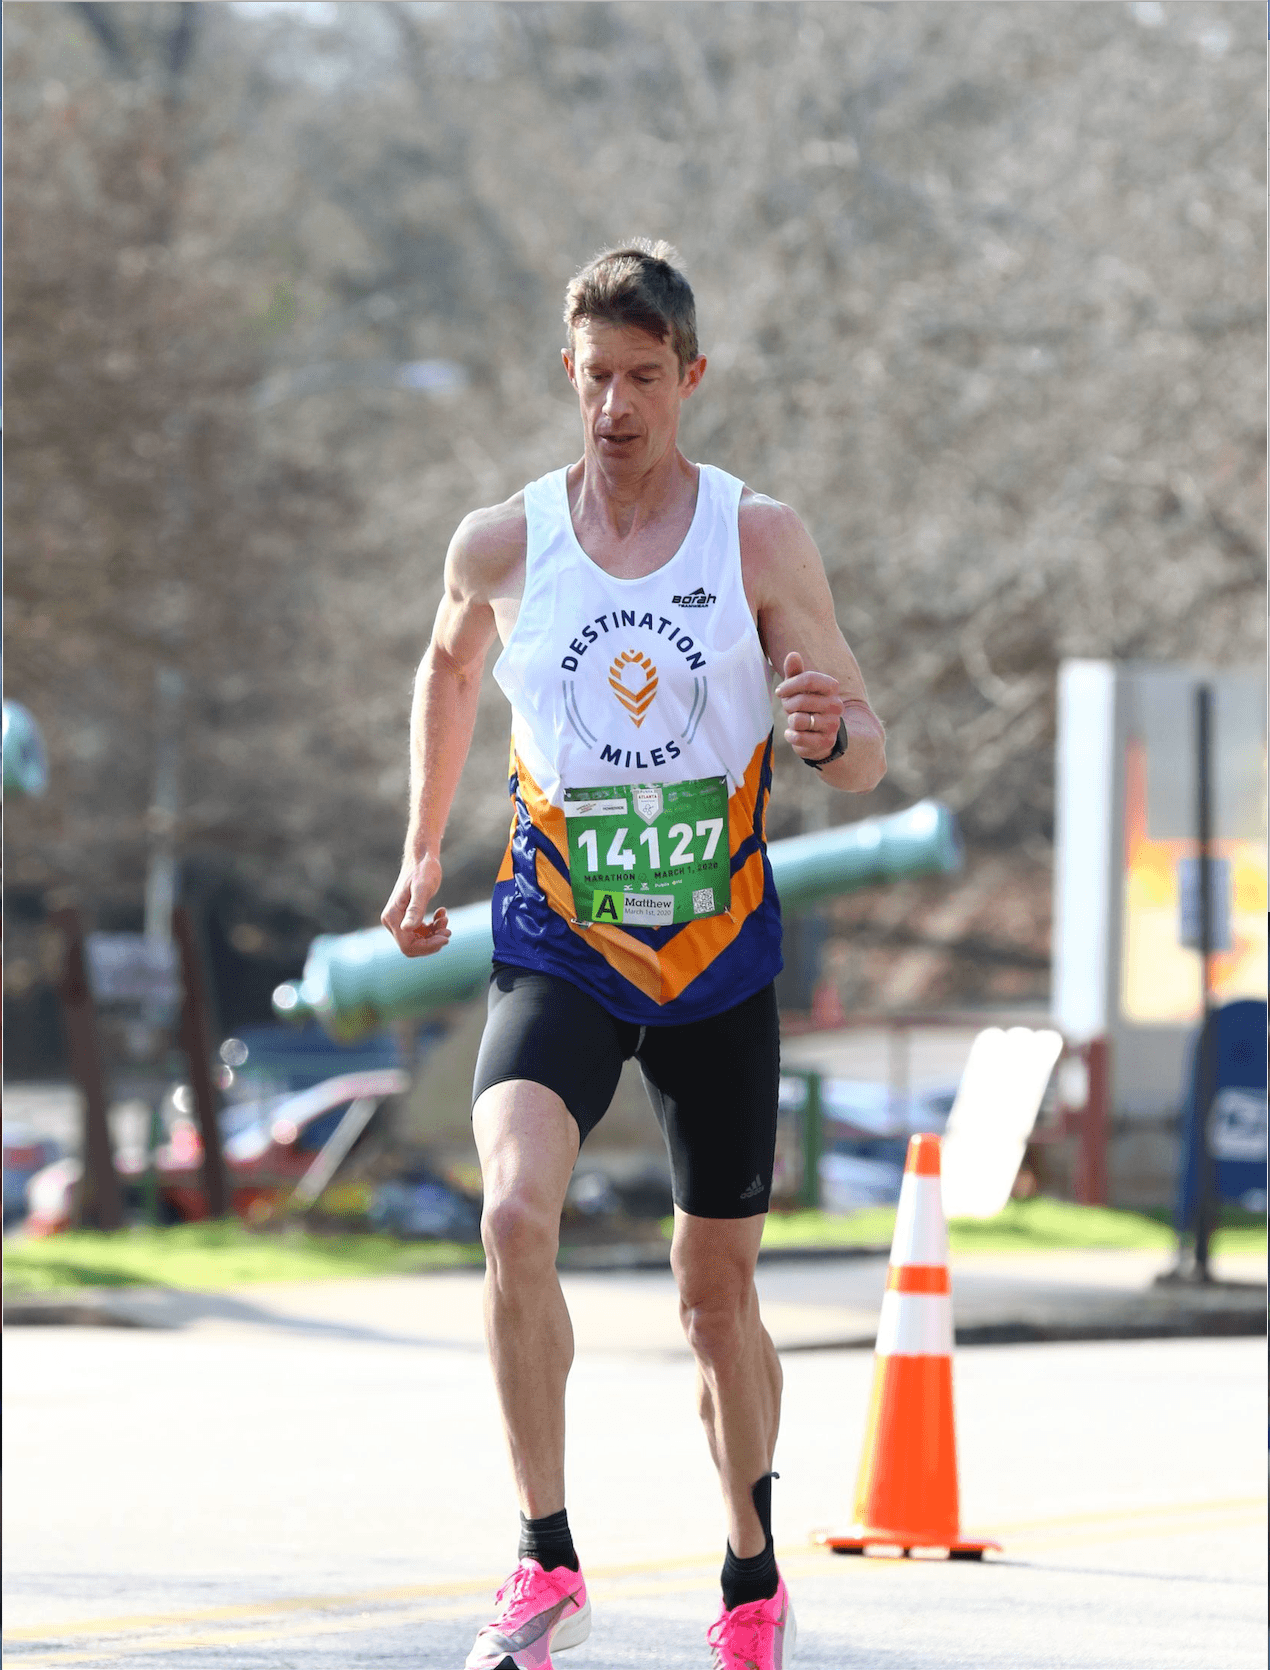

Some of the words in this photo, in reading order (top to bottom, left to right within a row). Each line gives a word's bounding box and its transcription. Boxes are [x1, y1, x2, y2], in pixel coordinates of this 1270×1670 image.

[561, 610, 706, 672] DESTINATION
[600, 740, 681, 768] MILES
[577, 818, 724, 872] 14127
[584, 873, 636, 882] MARATHON
[654, 867, 684, 879] MARCH
[697, 862, 718, 871] 2020
[595, 894, 618, 920] A
[625, 898, 672, 908] Matthew
